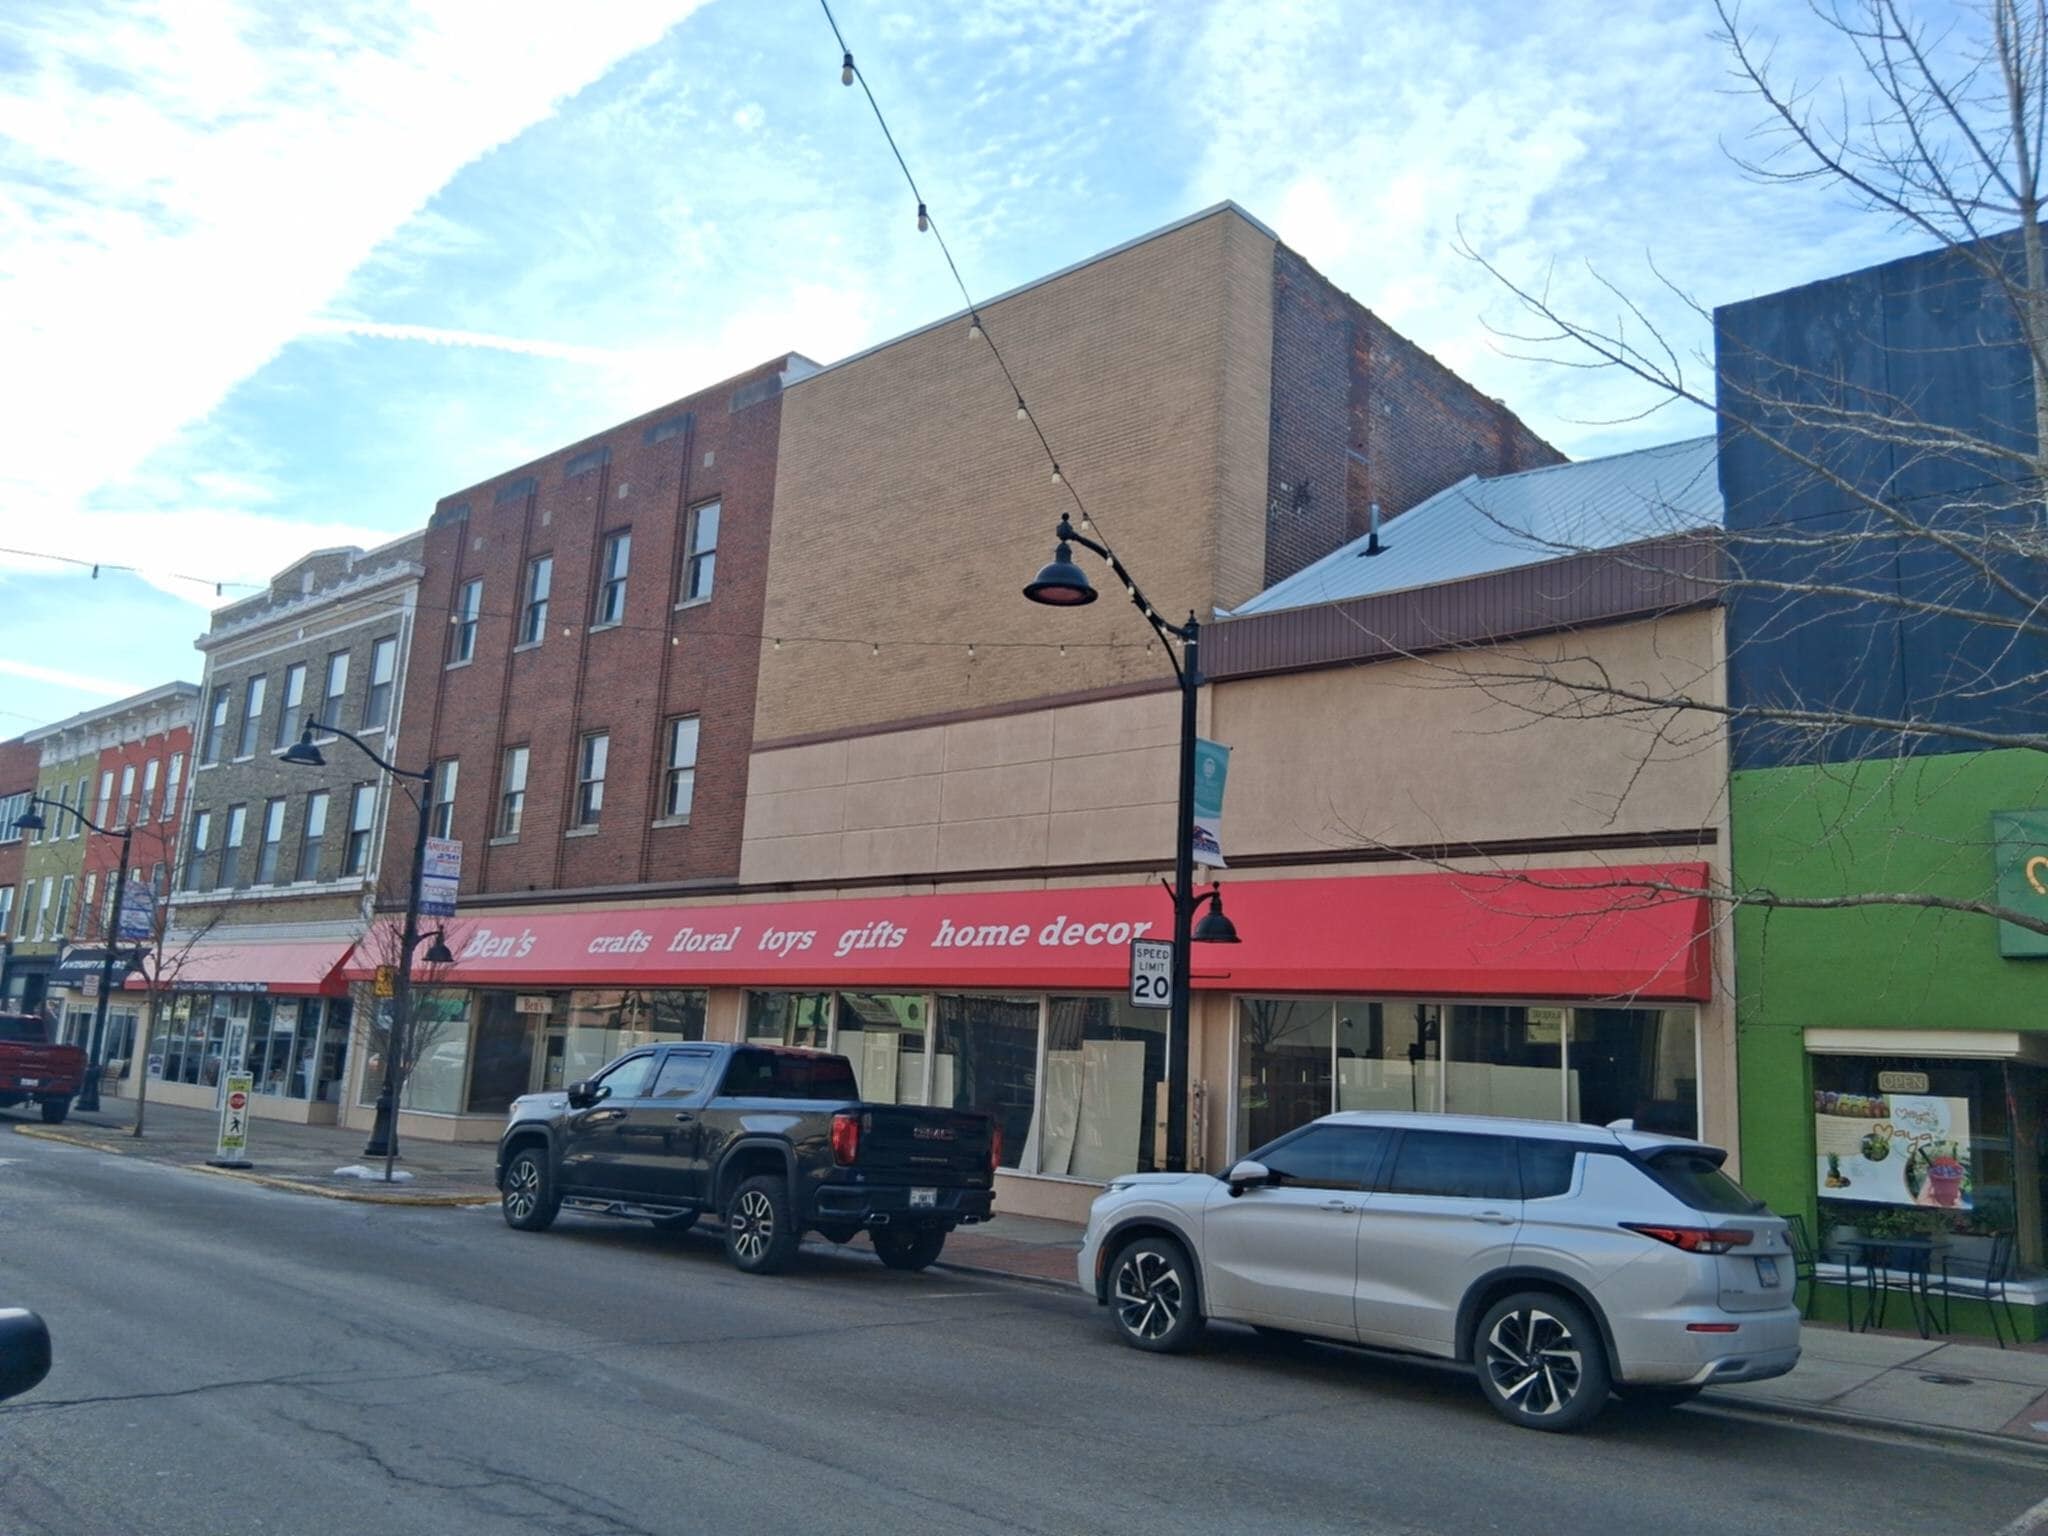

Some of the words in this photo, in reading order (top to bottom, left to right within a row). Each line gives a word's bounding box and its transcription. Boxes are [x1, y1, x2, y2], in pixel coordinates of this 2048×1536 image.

[462, 929, 537, 958] Ben's
[588, 929, 651, 954] crafts
[667, 926, 742, 952] floral
[758, 926, 816, 958] toys
[833, 920, 908, 958] gifts
[930, 919, 1031, 947] home
[1038, 915, 1153, 945] decor
[1136, 948, 1169, 960] SPEED
[1139, 961, 1165, 972] LIMIT
[1135, 974, 1169, 999] 20
[1882, 1074, 1924, 1088] OPEN
[1872, 1123, 1932, 1154] Maya
